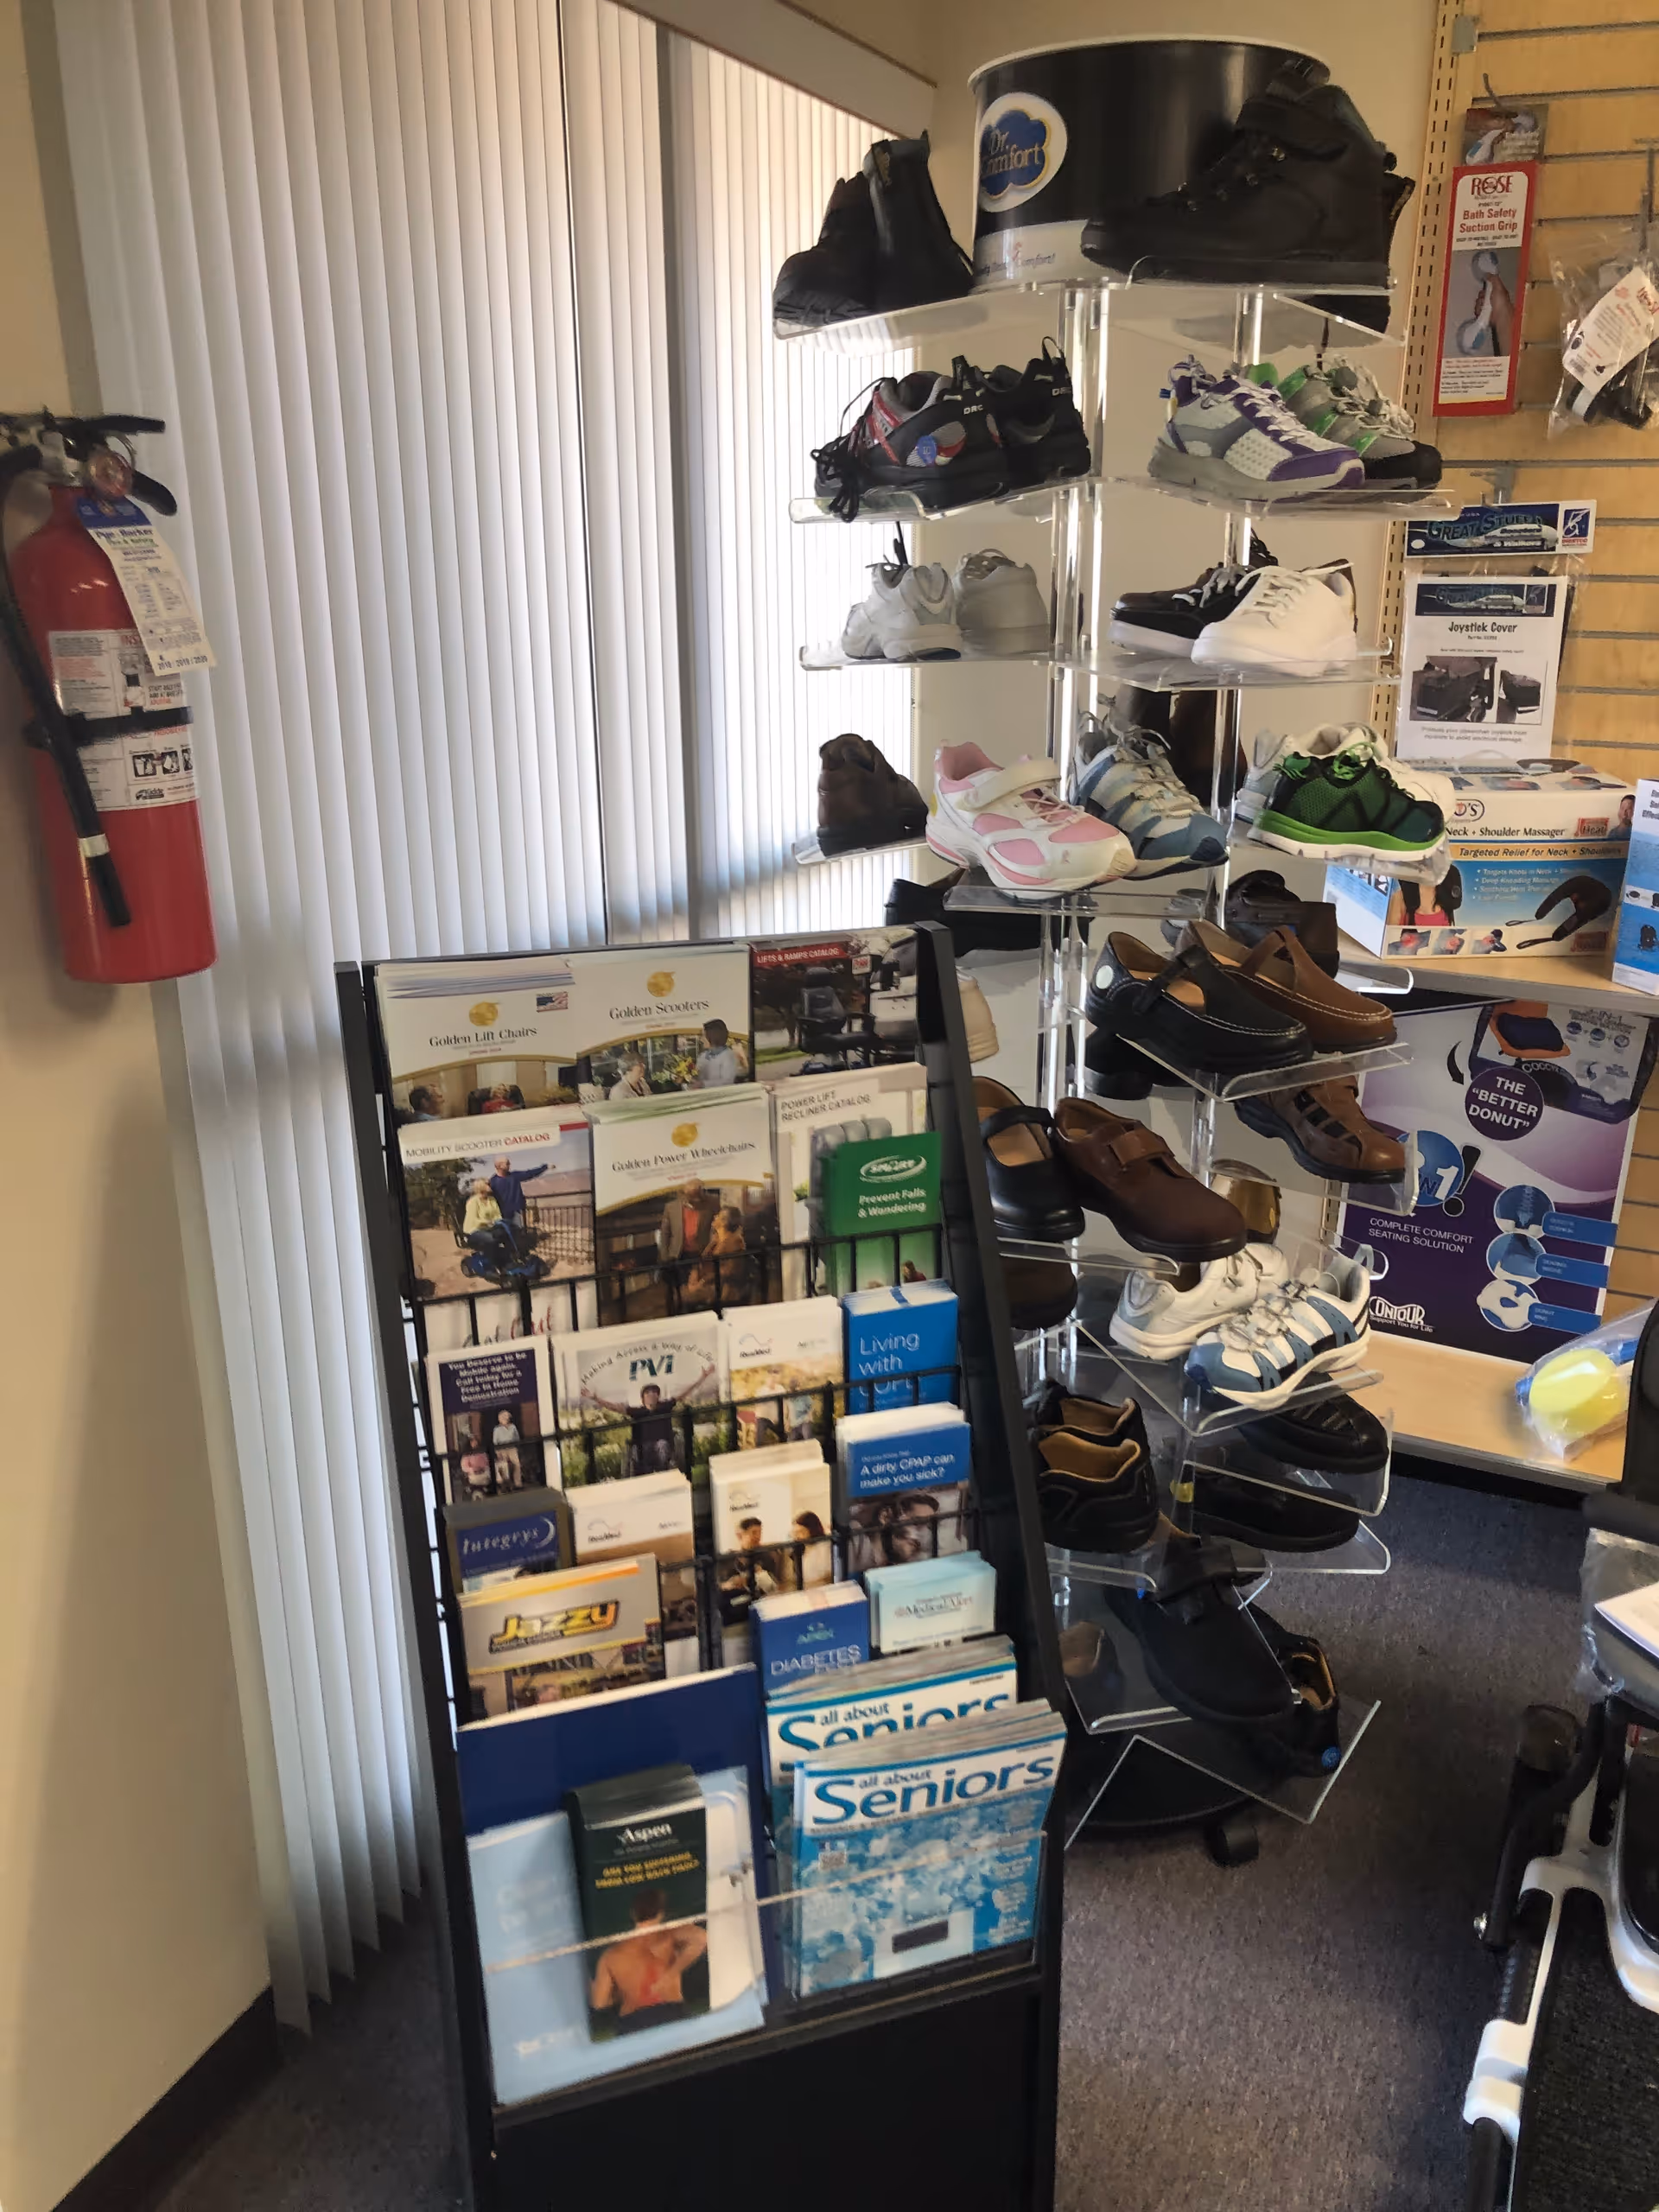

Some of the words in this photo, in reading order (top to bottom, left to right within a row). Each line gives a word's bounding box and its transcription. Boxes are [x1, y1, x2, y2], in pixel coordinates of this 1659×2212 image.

[990, 129, 1009, 156] Dr.
[1471, 175, 1513, 196] ROSE
[1463, 209, 1484, 219] Bath
[1487, 208, 1517, 219] Safety
[1459, 223, 1495, 233] Suction
[1497, 220, 1518, 232] Grip
[1448, 621, 1488, 633] Joystick
[1491, 622, 1517, 632] Cover
[1453, 802, 1479, 817] O'S
[1446, 827, 1469, 836] Neck
[1479, 827, 1521, 836] Shoulder
[1523, 828, 1566, 838] Massager
[1459, 848, 1500, 858] Targeted
[1502, 847, 1529, 856] Relief
[1531, 848, 1544, 856] for
[609, 1006, 652, 1020] Golden
[655, 1001, 709, 1014] Scooters
[429, 1034, 471, 1047] Golden
[474, 1031, 495, 1042] Lift
[499, 1027, 538, 1039] Chairs
[1496, 1076, 1526, 1096] THE
[781, 1096, 816, 1110] POWER
[817, 1090, 836, 1103] LIFT
[781, 1103, 827, 1122] RECLINER
[828, 1094, 872, 1111] CATALOG
[405, 1144, 452, 1158] MOBILITY
[454, 1140, 503, 1153] SCOOTER
[504, 1133, 551, 1147] CATALOG
[612, 1158, 651, 1172] Golden
[654, 1153, 686, 1166] Power
[690, 1141, 756, 1159] Wheelchairs
[859, 1192, 900, 1205] Prevent
[901, 1187, 927, 1199] Falls
[858, 1208, 868, 1218] &
[868, 1202, 927, 1217] Wandering
[1370, 1217, 1421, 1235] COMPLETE
[1422, 1228, 1474, 1244] COMFORT
[1368, 1228, 1410, 1243] SEATING
[1412, 1236, 1465, 1254] SOLUTION
[1369, 1296, 1426, 1325] CONTOUR
[1370, 1314, 1396, 1325] Support
[860, 1332, 920, 1355] Living
[448, 1363, 465, 1371] You
[466, 1356, 503, 1368] Deserve
[505, 1353, 515, 1362] to
[515, 1351, 528, 1360] be
[581, 1356, 613, 1385] Making
[615, 1345, 648, 1359] Access
[858, 1353, 903, 1376] with
[455, 1377, 474, 1387] Call
[474, 1374, 500, 1384] today
[459, 1367, 488, 1377] Mobile
[461, 1385, 481, 1395] Free
[493, 1379, 519, 1388] Home
[861, 1465, 870, 1476] A
[871, 1462, 897, 1474] dirty
[899, 1455, 932, 1470] CPAP
[933, 1453, 956, 1465] can
[860, 1477, 891, 1489] make
[893, 1473, 913, 1486] you
[915, 1466, 945, 1481] sick?
[490, 1600, 619, 1652] Jazzy
[771, 1644, 862, 1676] DIABETES
[819, 1710, 839, 1726] all
[842, 1702, 891, 1722] about
[859, 1774, 879, 1789] all
[882, 1769, 932, 1785] about
[811, 1756, 1055, 1825] Seniors
[620, 1823, 673, 1844] Aspen
